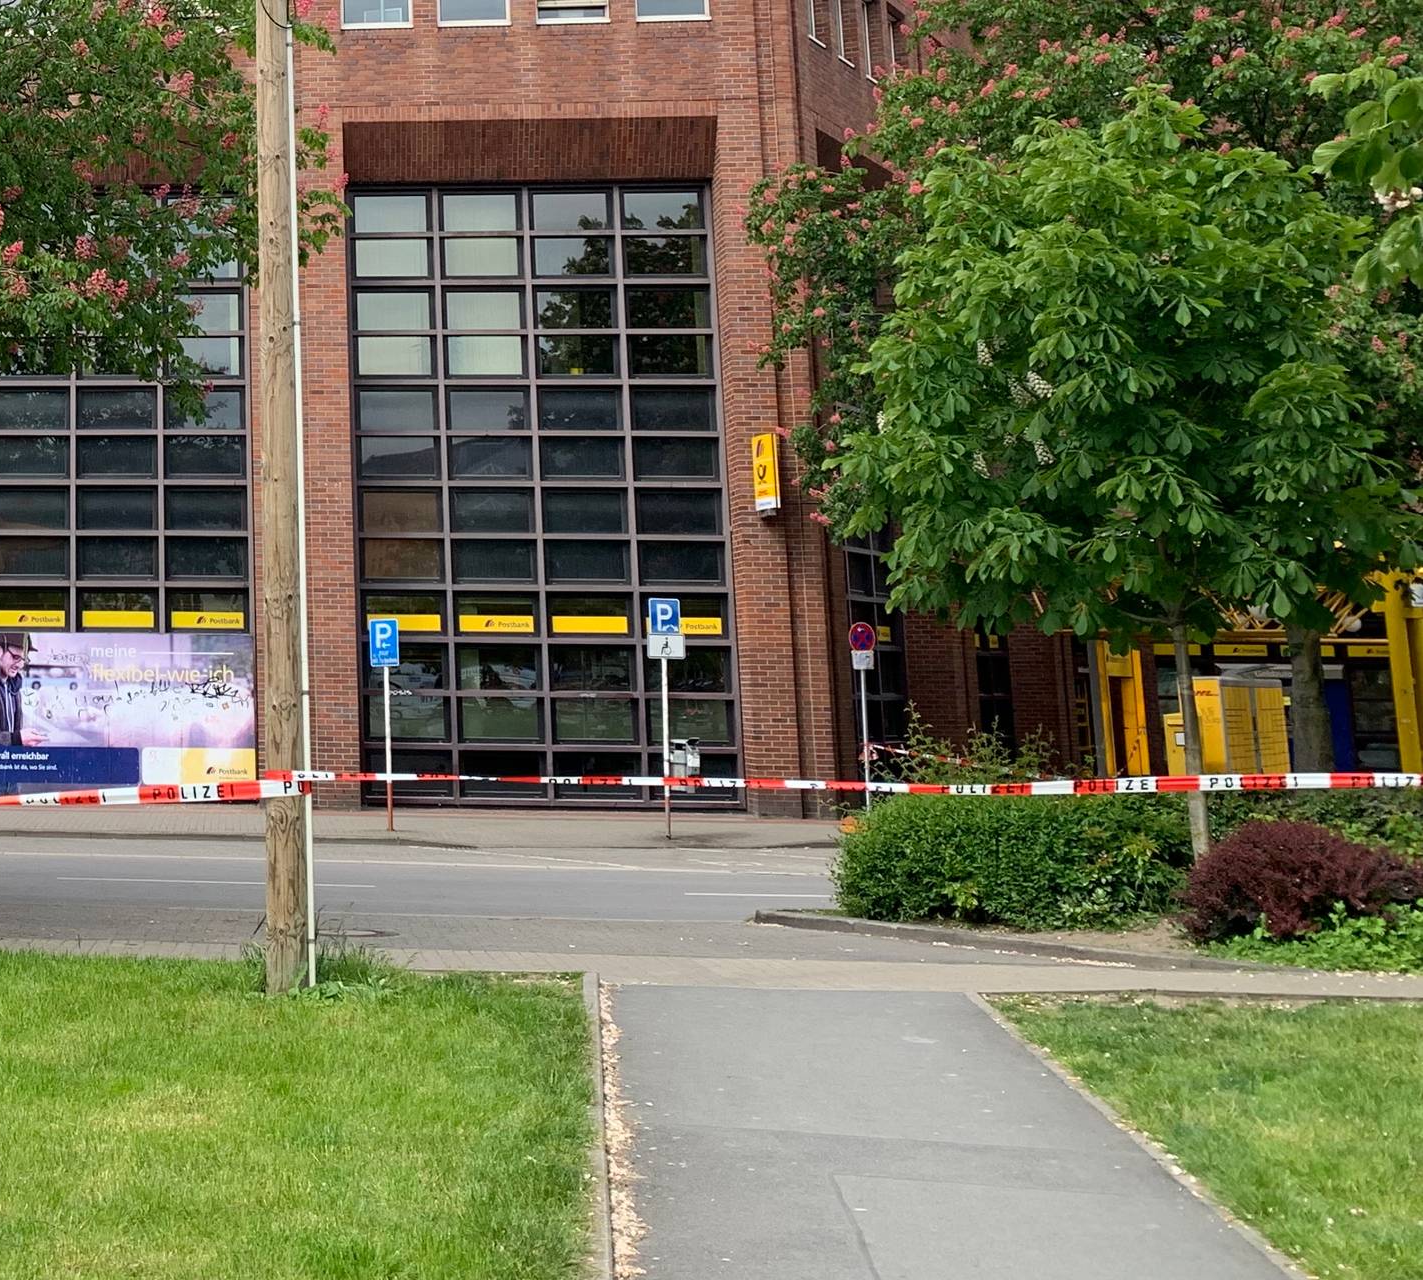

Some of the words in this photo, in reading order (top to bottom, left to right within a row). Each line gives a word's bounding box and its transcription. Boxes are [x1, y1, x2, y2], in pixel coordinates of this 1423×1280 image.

[31, 615, 61, 623] Postbank
[209, 617, 240, 625] Postbank
[90, 644, 137, 658] meine
[11, 751, 50, 760] erreichbar
[1074, 779, 1159, 792] POLIZEI
[1210, 776, 1298, 788] POLIZEI
[153, 783, 235, 800] POLIZEI
